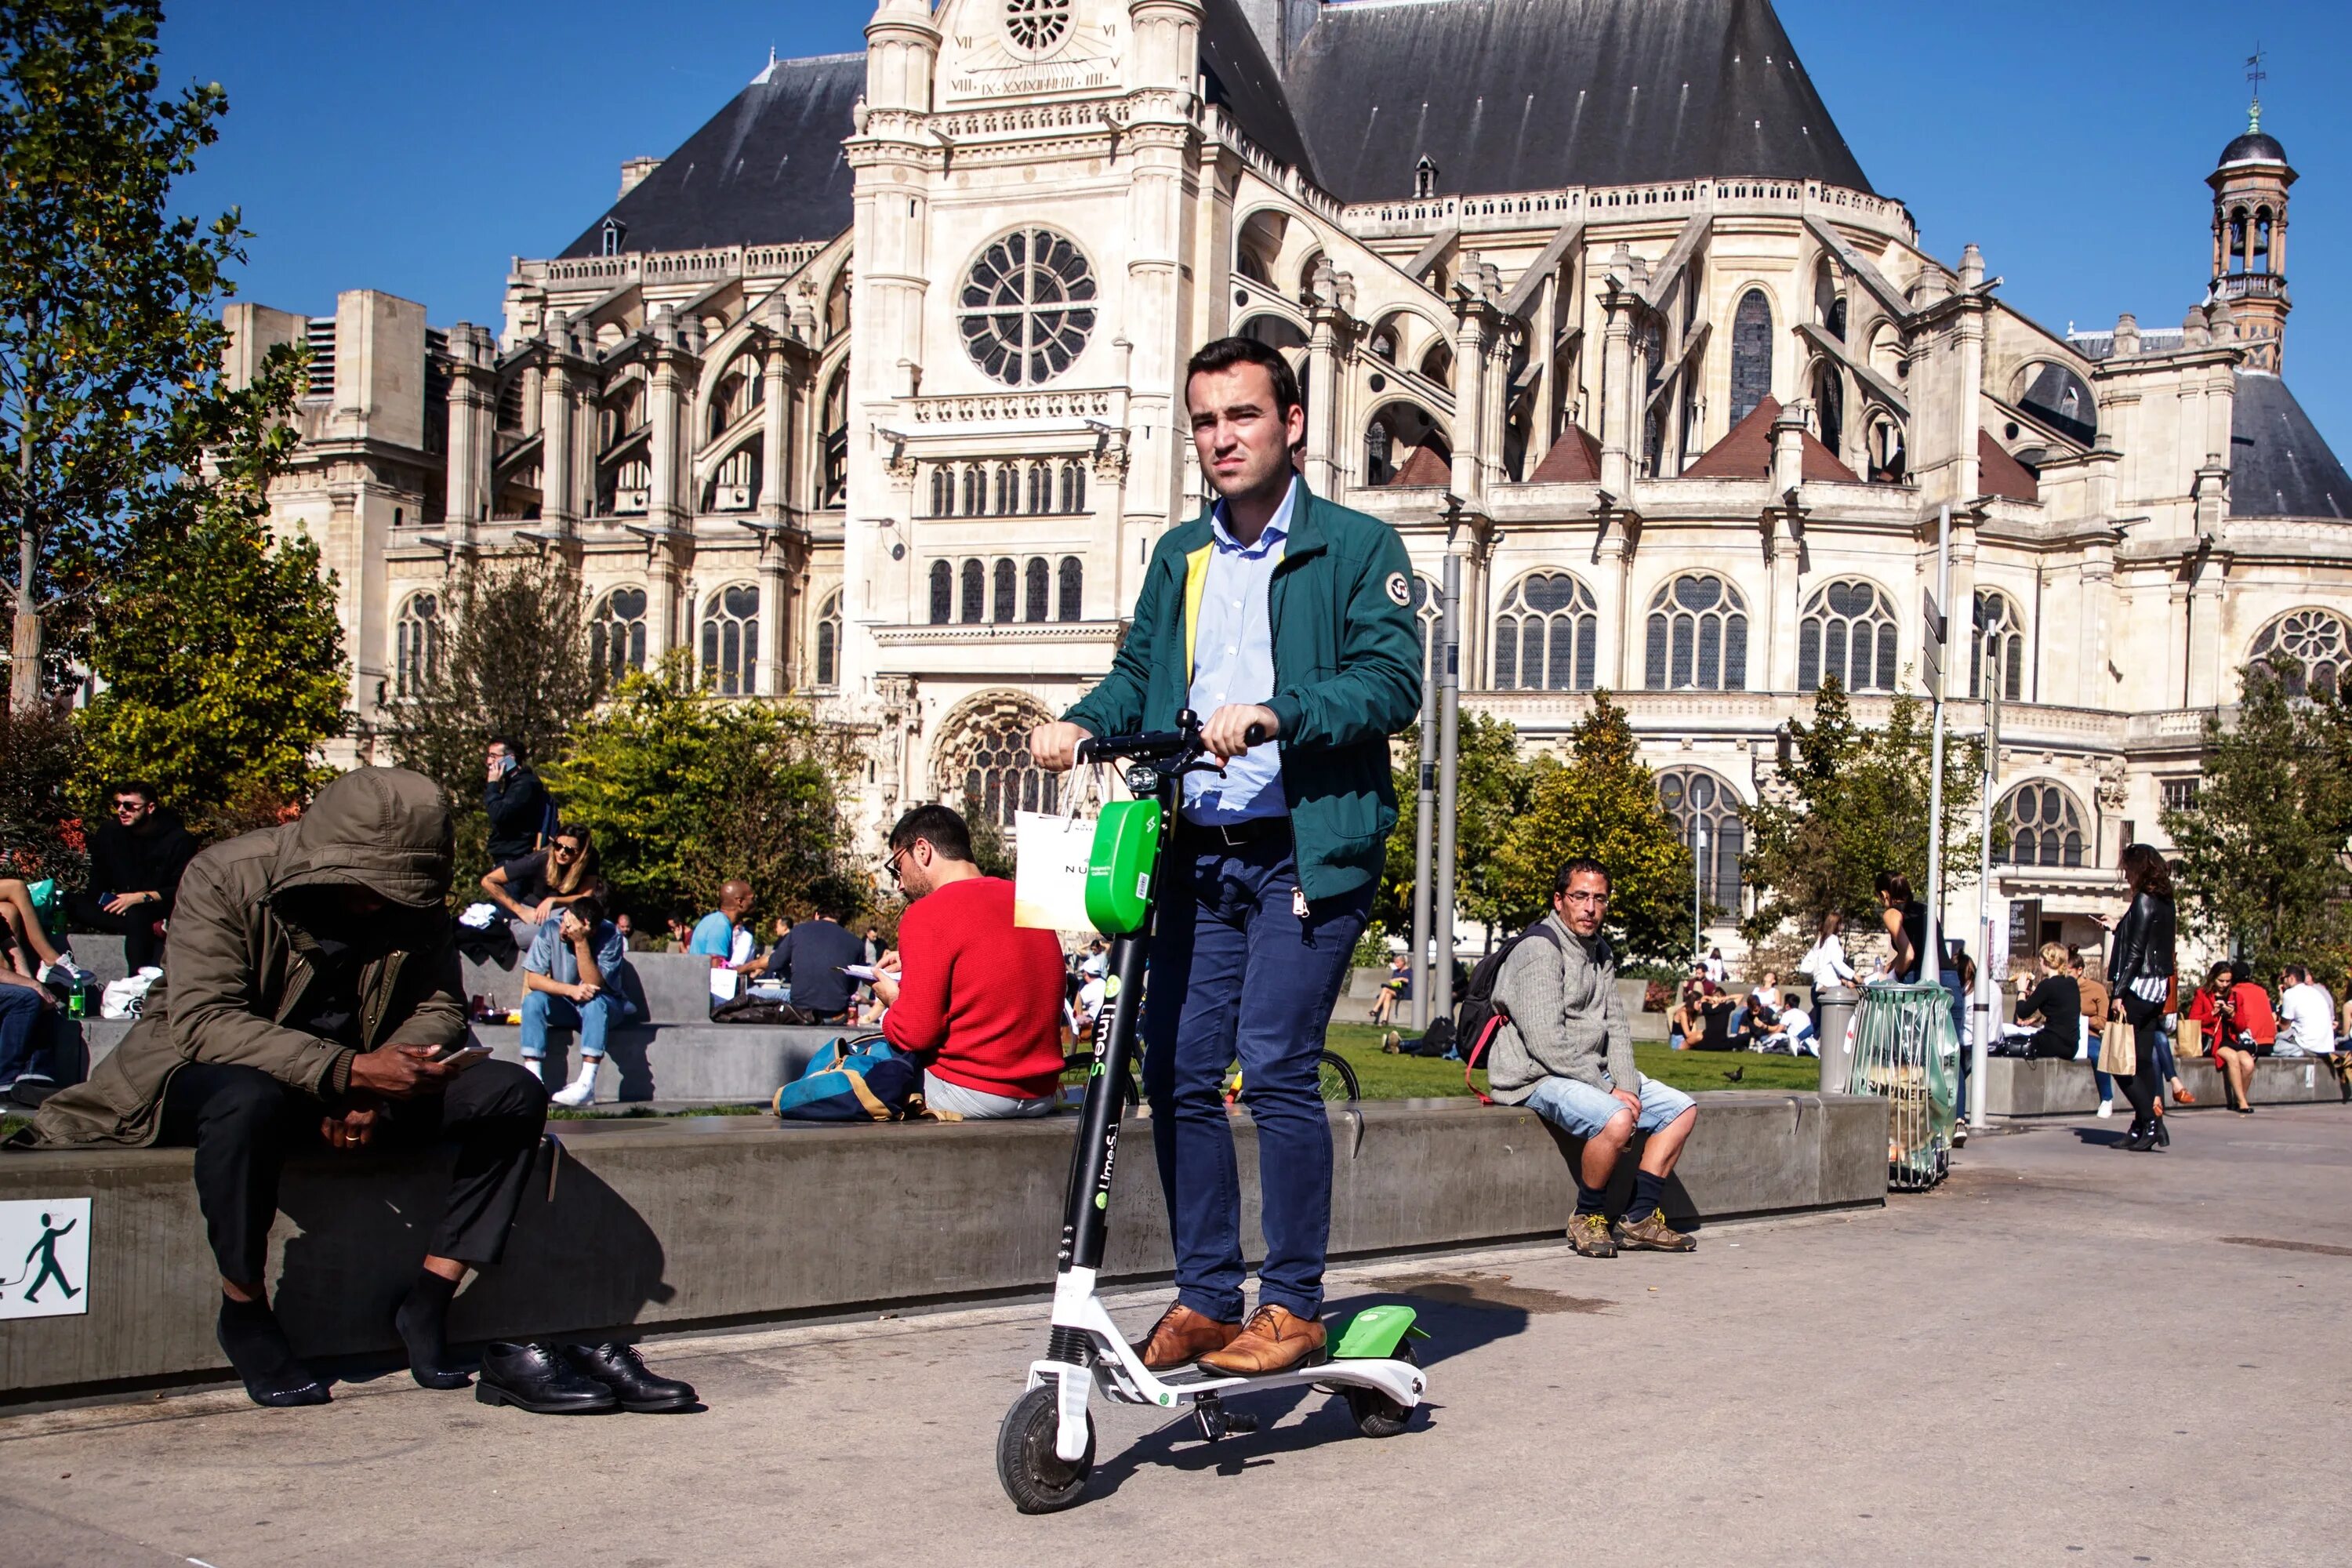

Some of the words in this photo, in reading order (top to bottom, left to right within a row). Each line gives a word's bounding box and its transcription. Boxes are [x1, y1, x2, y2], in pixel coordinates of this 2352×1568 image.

[1103, 24, 1116, 37] VI
[955, 36, 972, 49] VII
[1065, 865, 1087, 874] NU
